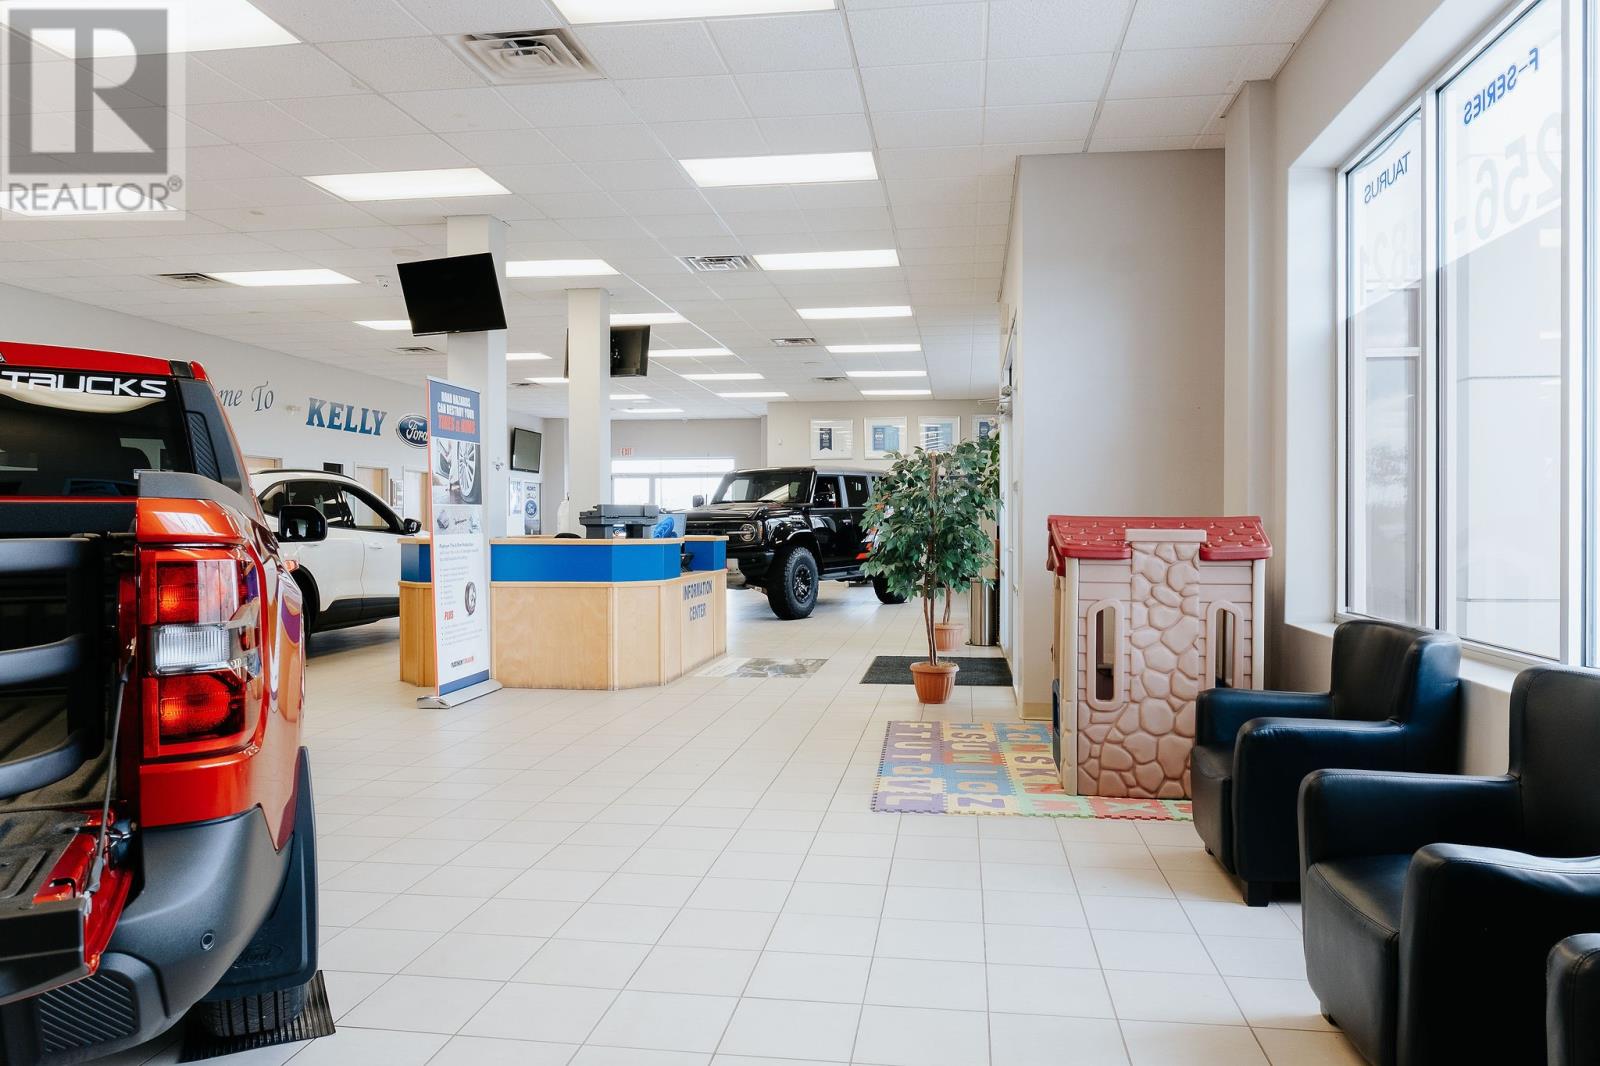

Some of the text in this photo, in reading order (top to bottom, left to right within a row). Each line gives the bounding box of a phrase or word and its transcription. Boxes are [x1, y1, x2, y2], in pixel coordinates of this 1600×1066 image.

[1, 371, 167, 399] TRUCKS
[251, 381, 274, 412] To
[305, 397, 388, 436] KELLY
[683, 580, 713, 600] INFORMATION
[444, 609, 454, 621] PLUS
[689, 603, 706, 621] CENTER
